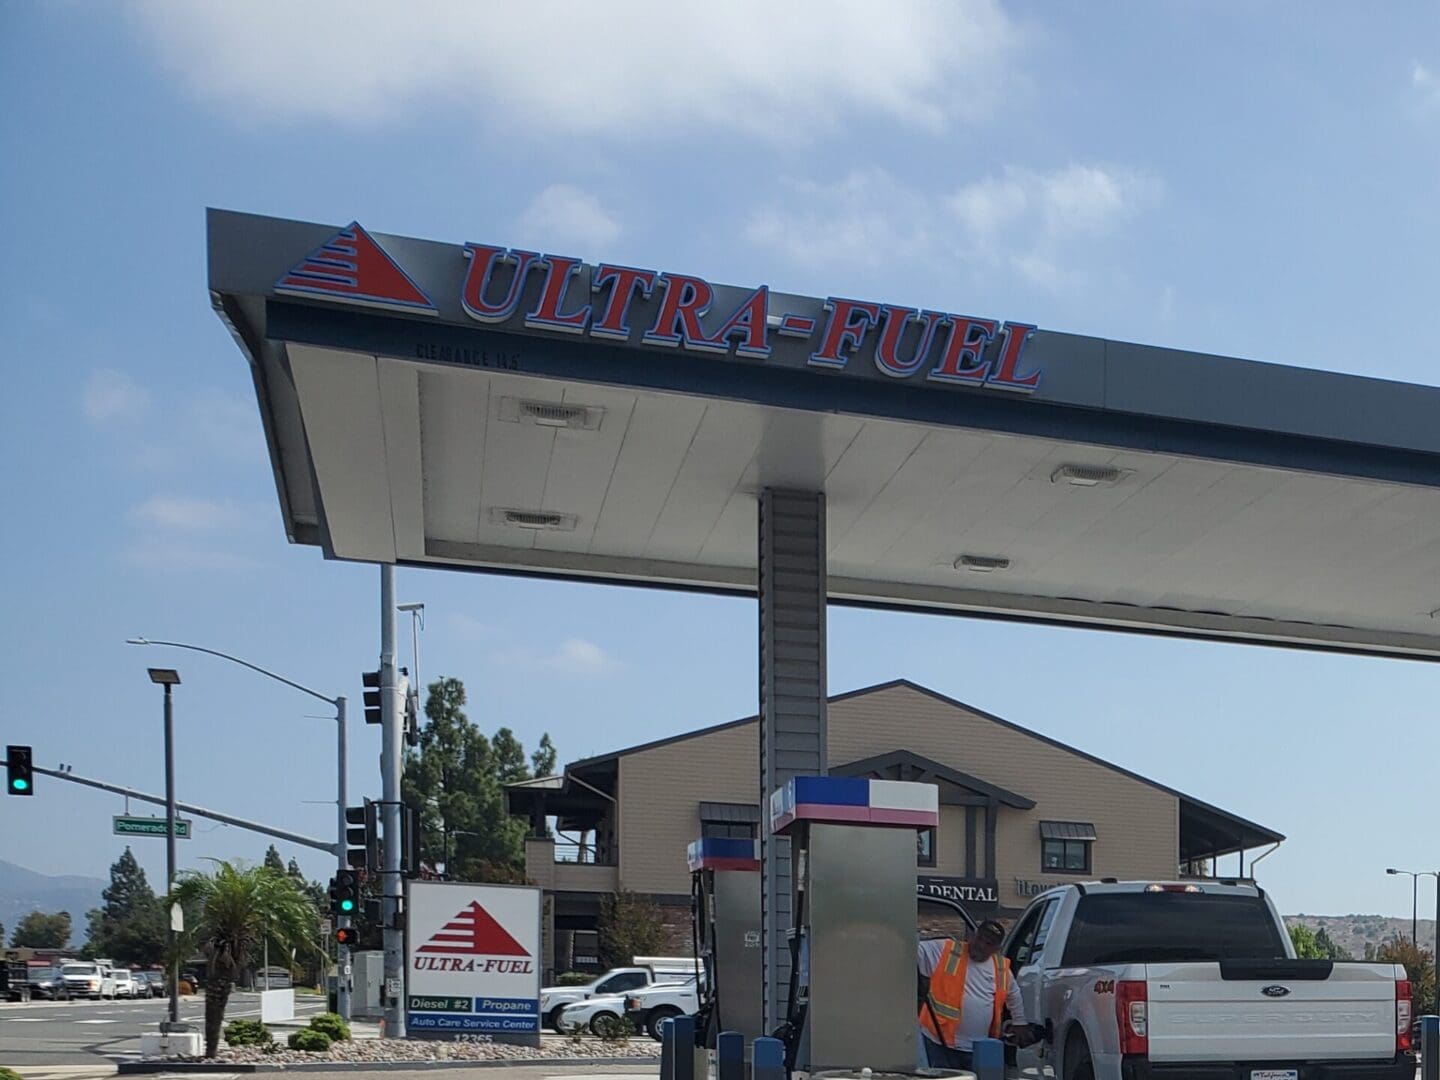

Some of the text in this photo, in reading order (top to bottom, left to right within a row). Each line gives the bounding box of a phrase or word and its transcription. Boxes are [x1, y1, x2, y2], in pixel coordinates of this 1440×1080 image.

[461, 241, 1043, 394] ULTRA-FUEL
[930, 884, 998, 902] DENTAL
[414, 956, 534, 974] ULTRA-FUEL
[411, 998, 469, 1010] Diesel #2
[482, 999, 532, 1011] Propane
[411, 1016, 536, 1029] Auto Care Service Center
